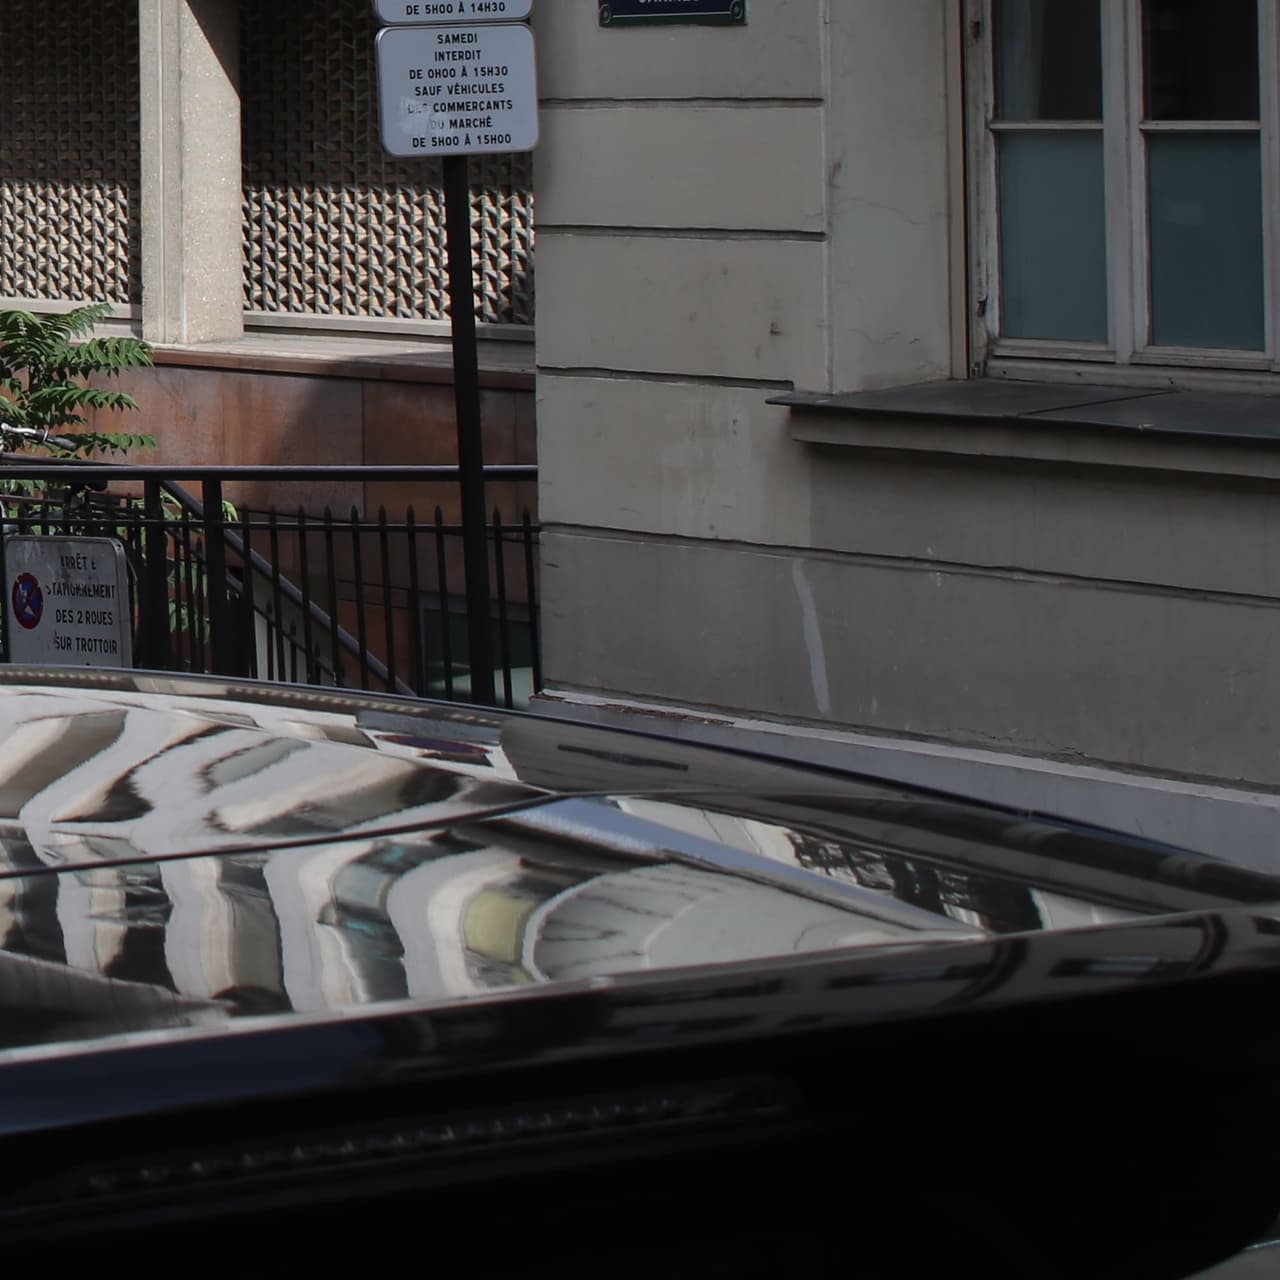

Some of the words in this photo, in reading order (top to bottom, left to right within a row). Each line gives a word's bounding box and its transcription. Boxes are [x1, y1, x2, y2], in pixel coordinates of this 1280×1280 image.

[406, 4, 420, 16] DE
[425, 3, 453, 15] 5H00
[458, 1, 465, 13] À
[471, 2, 506, 13] 14H30
[437, 33, 478, 44] SAMEDI
[434, 50, 482, 62] INTERDIT
[409, 69, 423, 80] DE
[427, 68, 456, 79] 0H00
[461, 66, 468, 77] À
[474, 66, 509, 77] 15H30
[414, 85, 442, 97] SAUF
[447, 83, 505, 95] VÉHICULES
[449, 117, 493, 129] MARCHÉ
[412, 137, 426, 148] DE
[431, 136, 459, 147] 5H00
[464, 133, 471, 146] À
[477, 134, 512, 145] 15H00
[55, 609, 74, 624] DES
[77, 610, 83, 625] 2
[85, 610, 113, 626] ROUES
[55, 637, 73, 651] SUR
[76, 638, 117, 654] TROTTOIR
